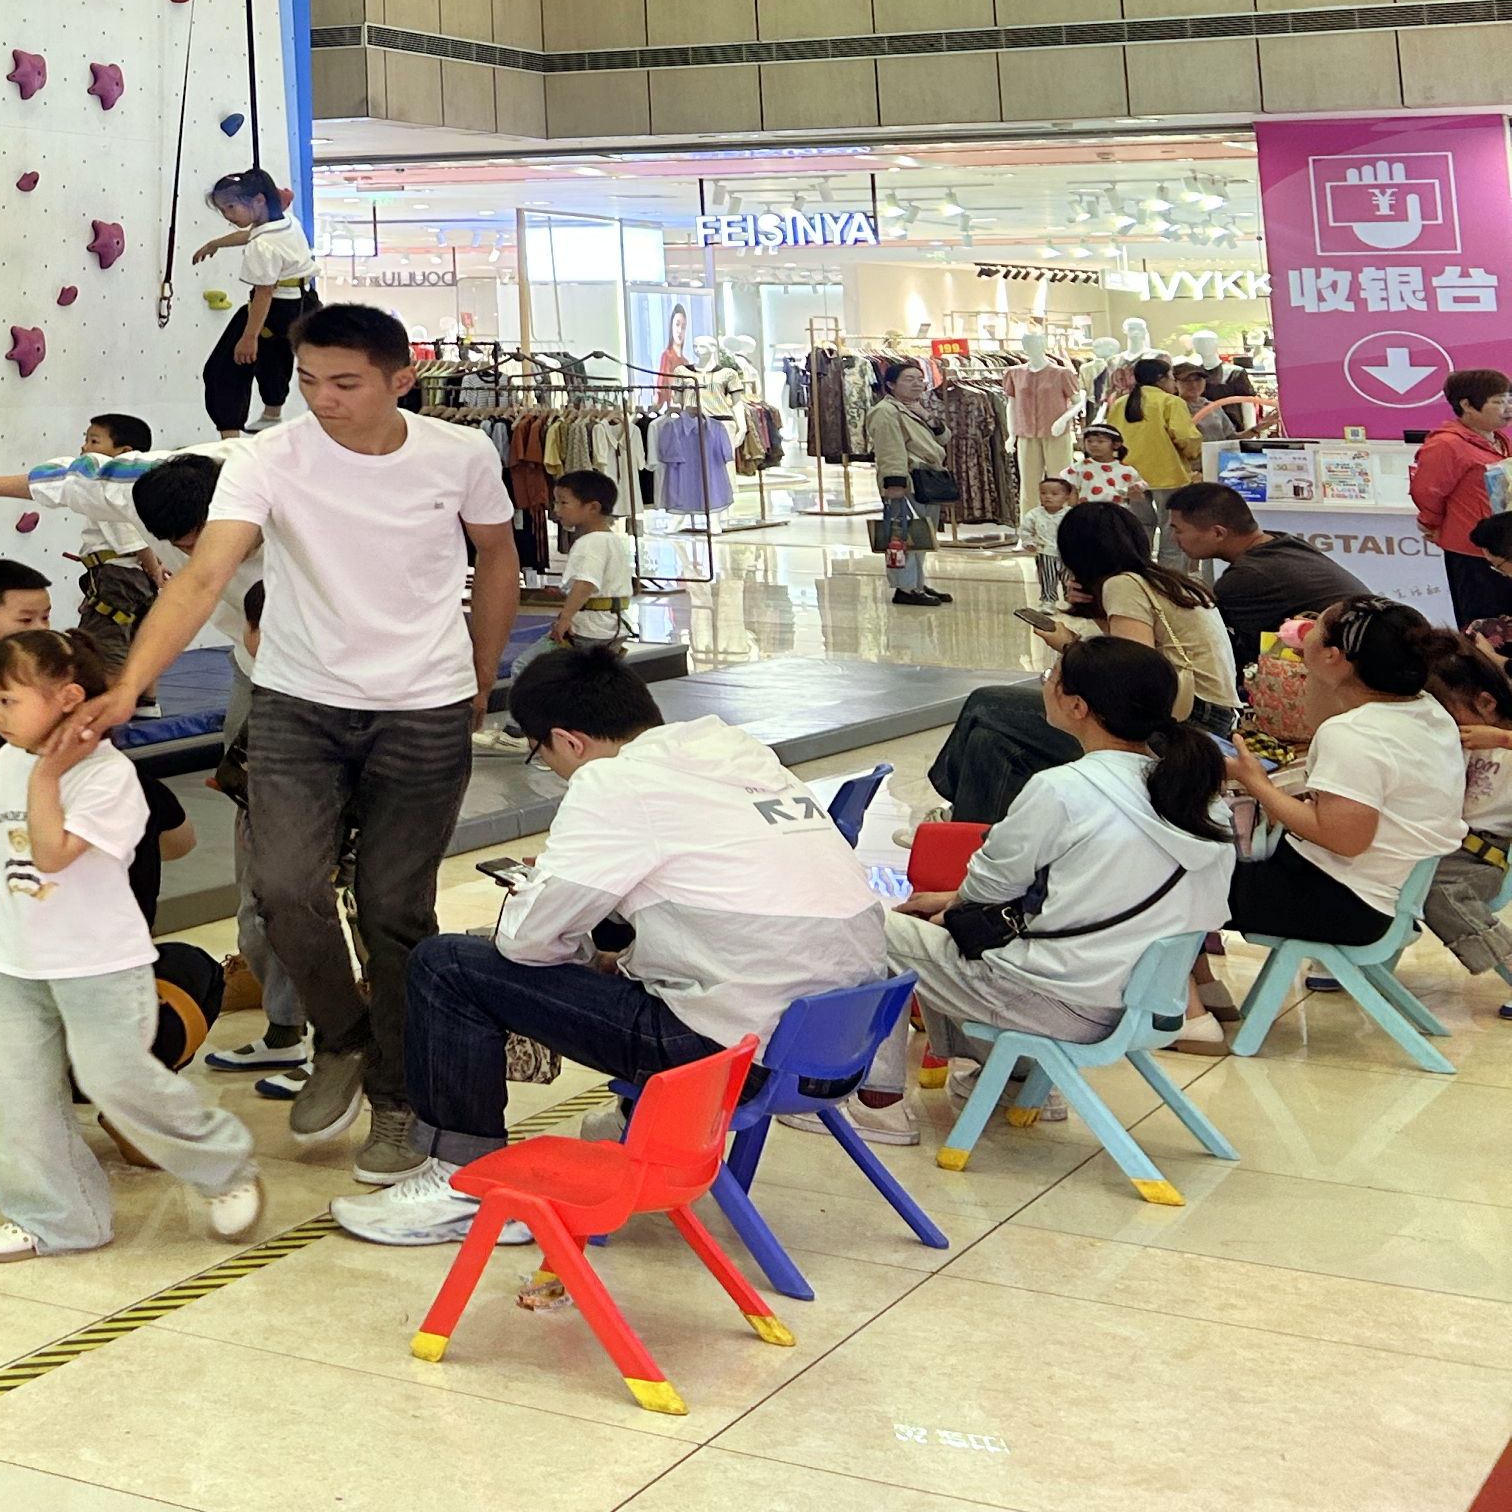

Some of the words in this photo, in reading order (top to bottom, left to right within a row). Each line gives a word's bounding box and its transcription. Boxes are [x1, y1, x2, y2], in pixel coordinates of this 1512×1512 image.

[695, 212, 878, 248] FEISINYA
[1289, 266, 1499, 314] 收银台
[1296, 532, 1442, 558] GTAICL
